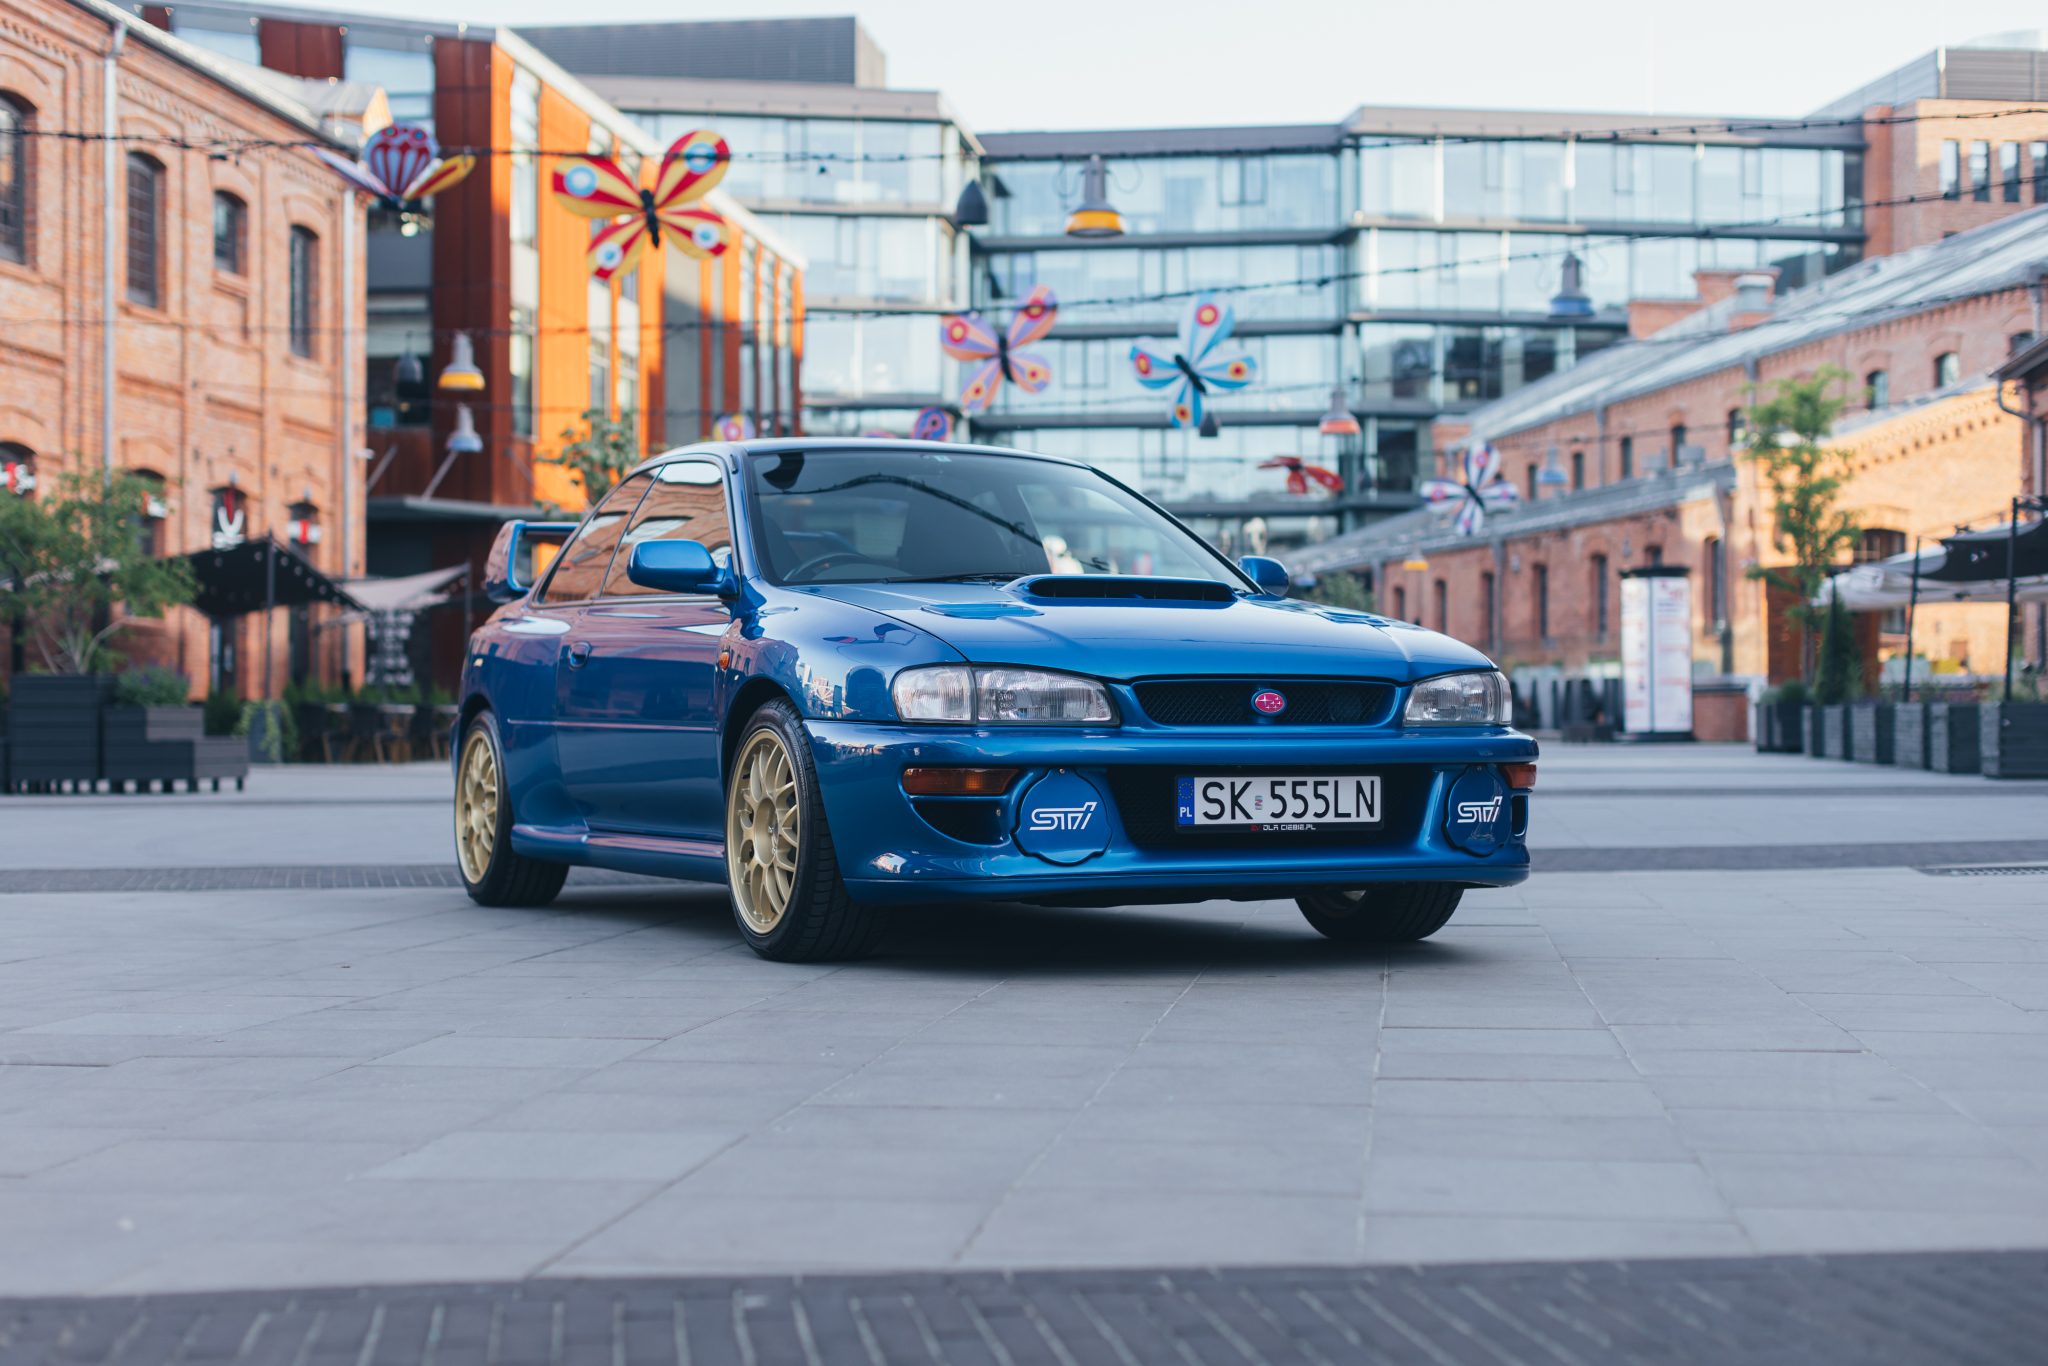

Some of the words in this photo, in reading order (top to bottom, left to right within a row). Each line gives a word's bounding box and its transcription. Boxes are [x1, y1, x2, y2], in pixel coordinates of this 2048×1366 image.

[1179, 806, 1192, 818] PL
[1201, 781, 1253, 820] SK
[1269, 780, 1375, 818] 555LN
